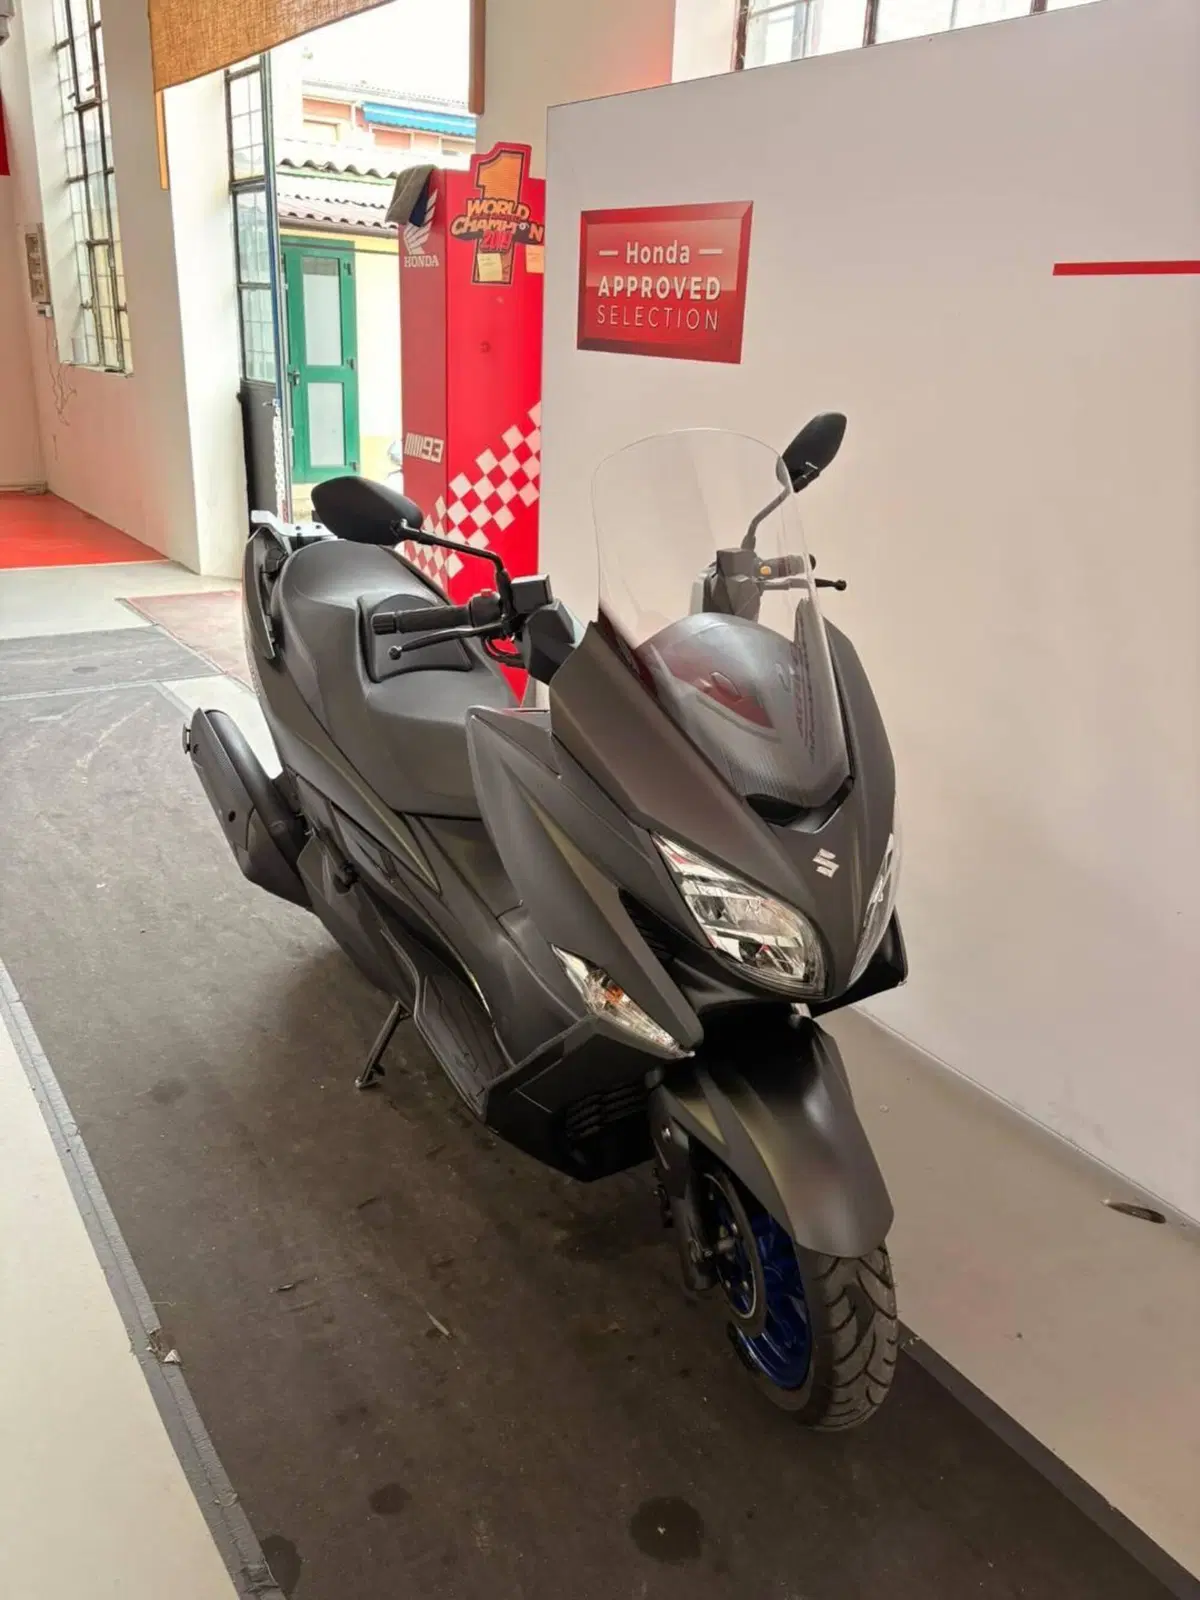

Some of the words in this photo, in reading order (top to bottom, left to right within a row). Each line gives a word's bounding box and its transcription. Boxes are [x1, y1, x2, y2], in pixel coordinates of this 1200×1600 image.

[467, 199, 531, 219] WORLD
[403, 254, 439, 268] HONDA
[626, 240, 691, 264] Honda
[598, 275, 721, 301] APPROVED
[597, 304, 719, 331] SELECTION
